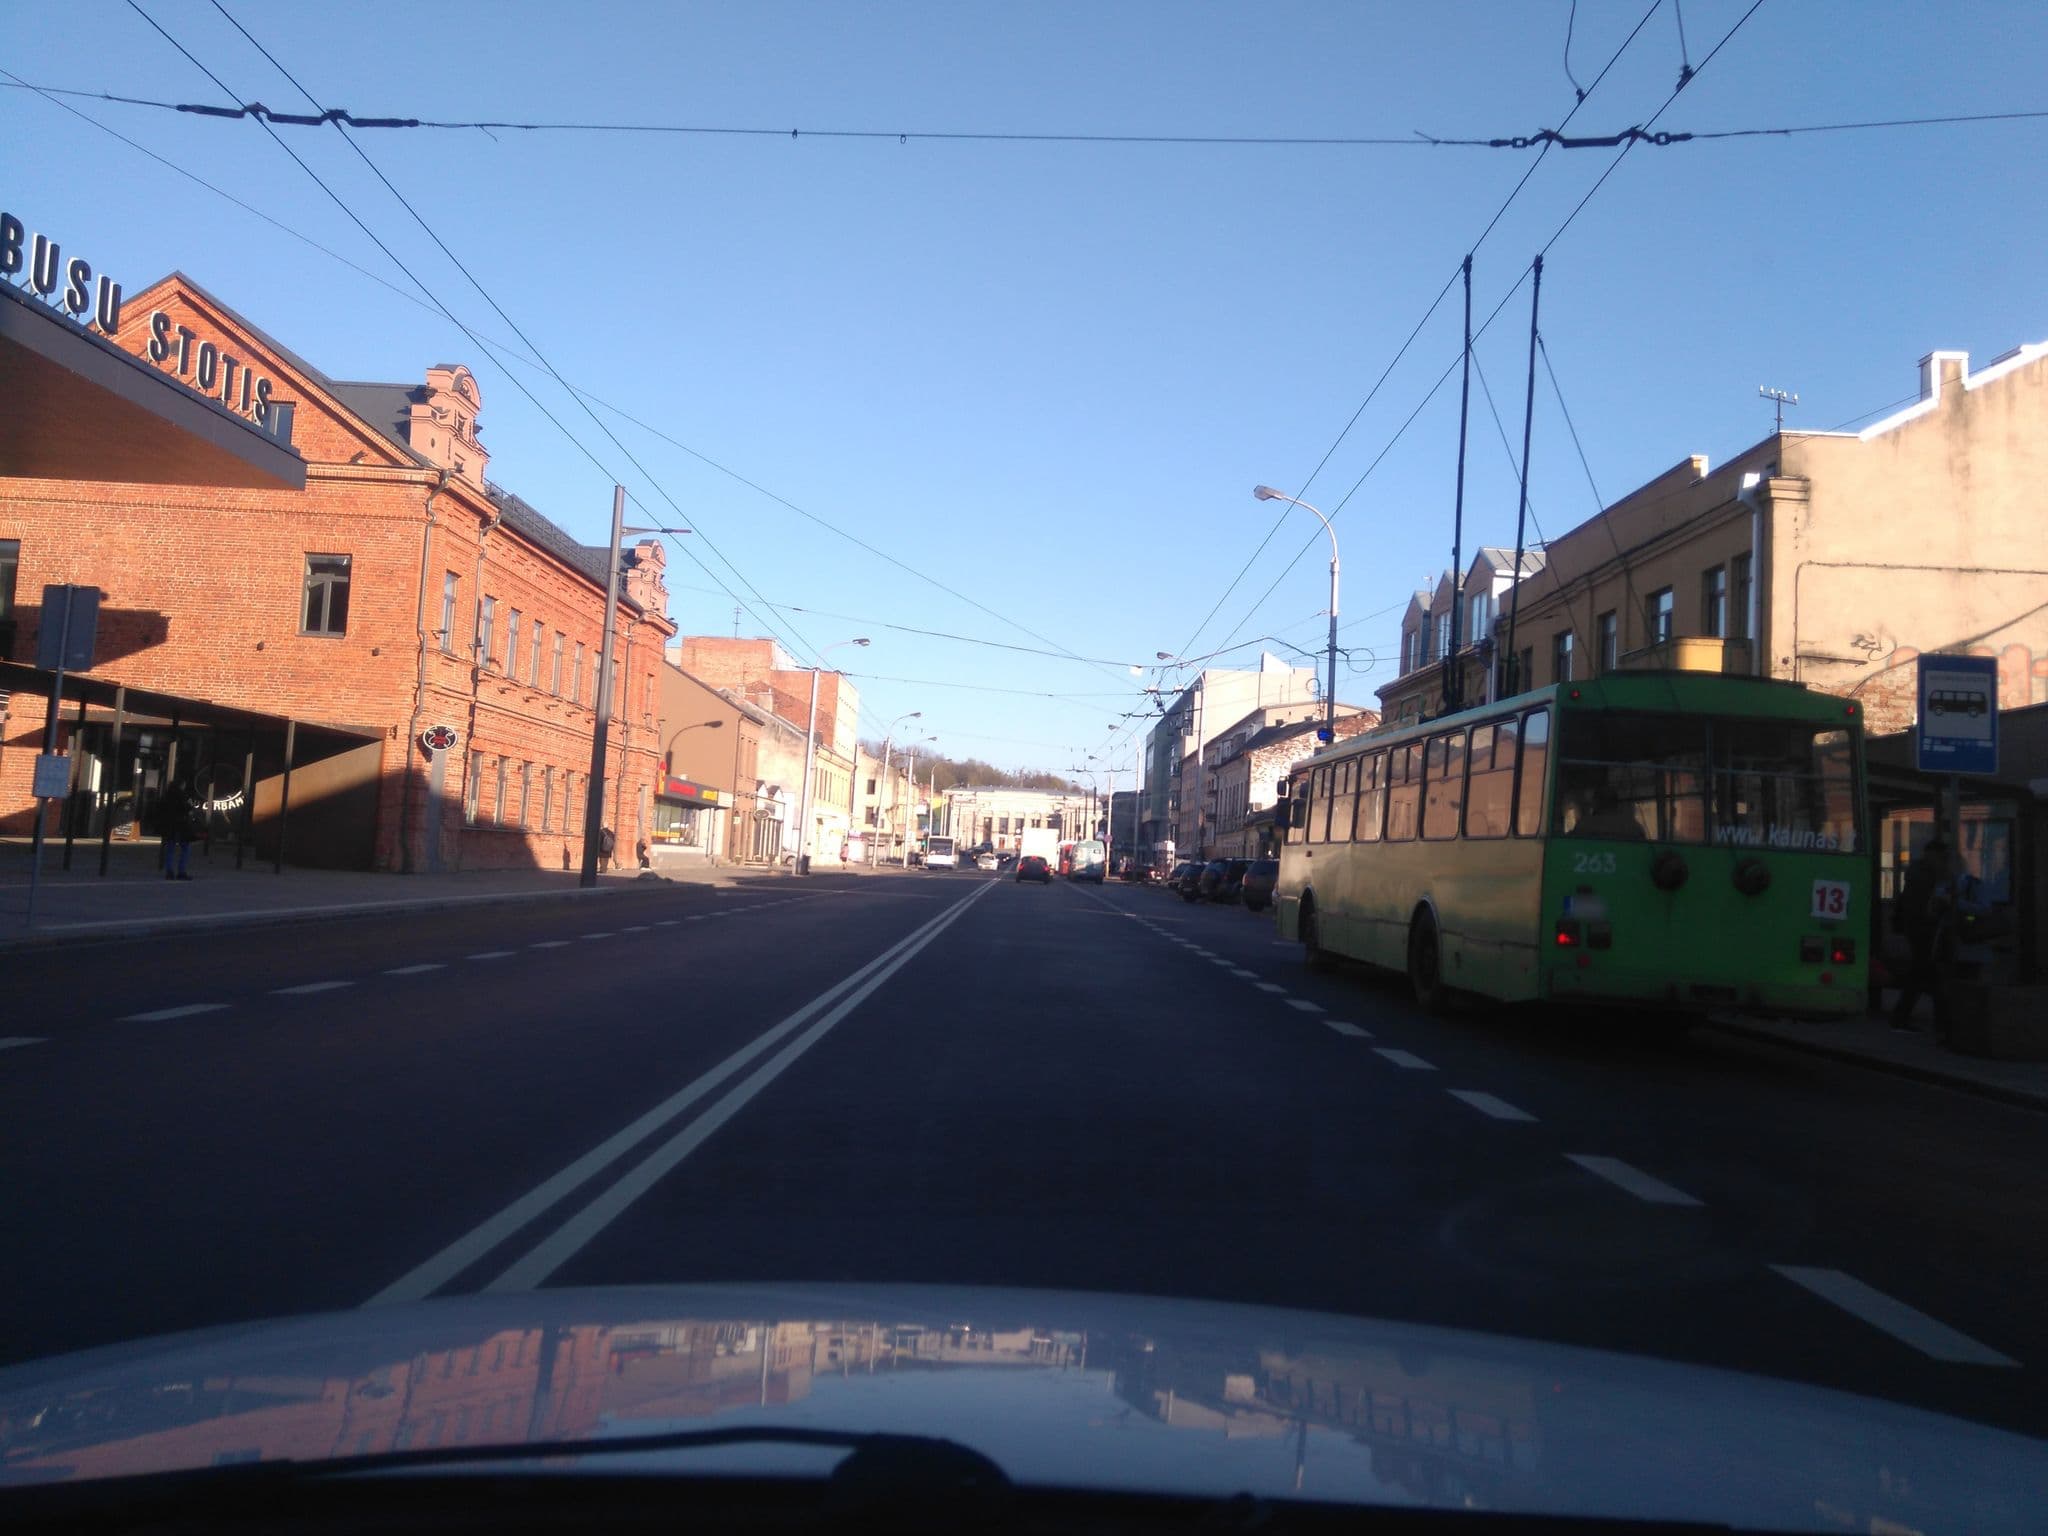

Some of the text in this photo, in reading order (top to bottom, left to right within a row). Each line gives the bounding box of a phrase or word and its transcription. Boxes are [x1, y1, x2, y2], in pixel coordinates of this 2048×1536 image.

[147, 309, 273, 427] STOTIS
[1715, 823, 1856, 850] www.kaunast
[1573, 851, 1617, 874] 263
[1815, 886, 1845, 915] 13
